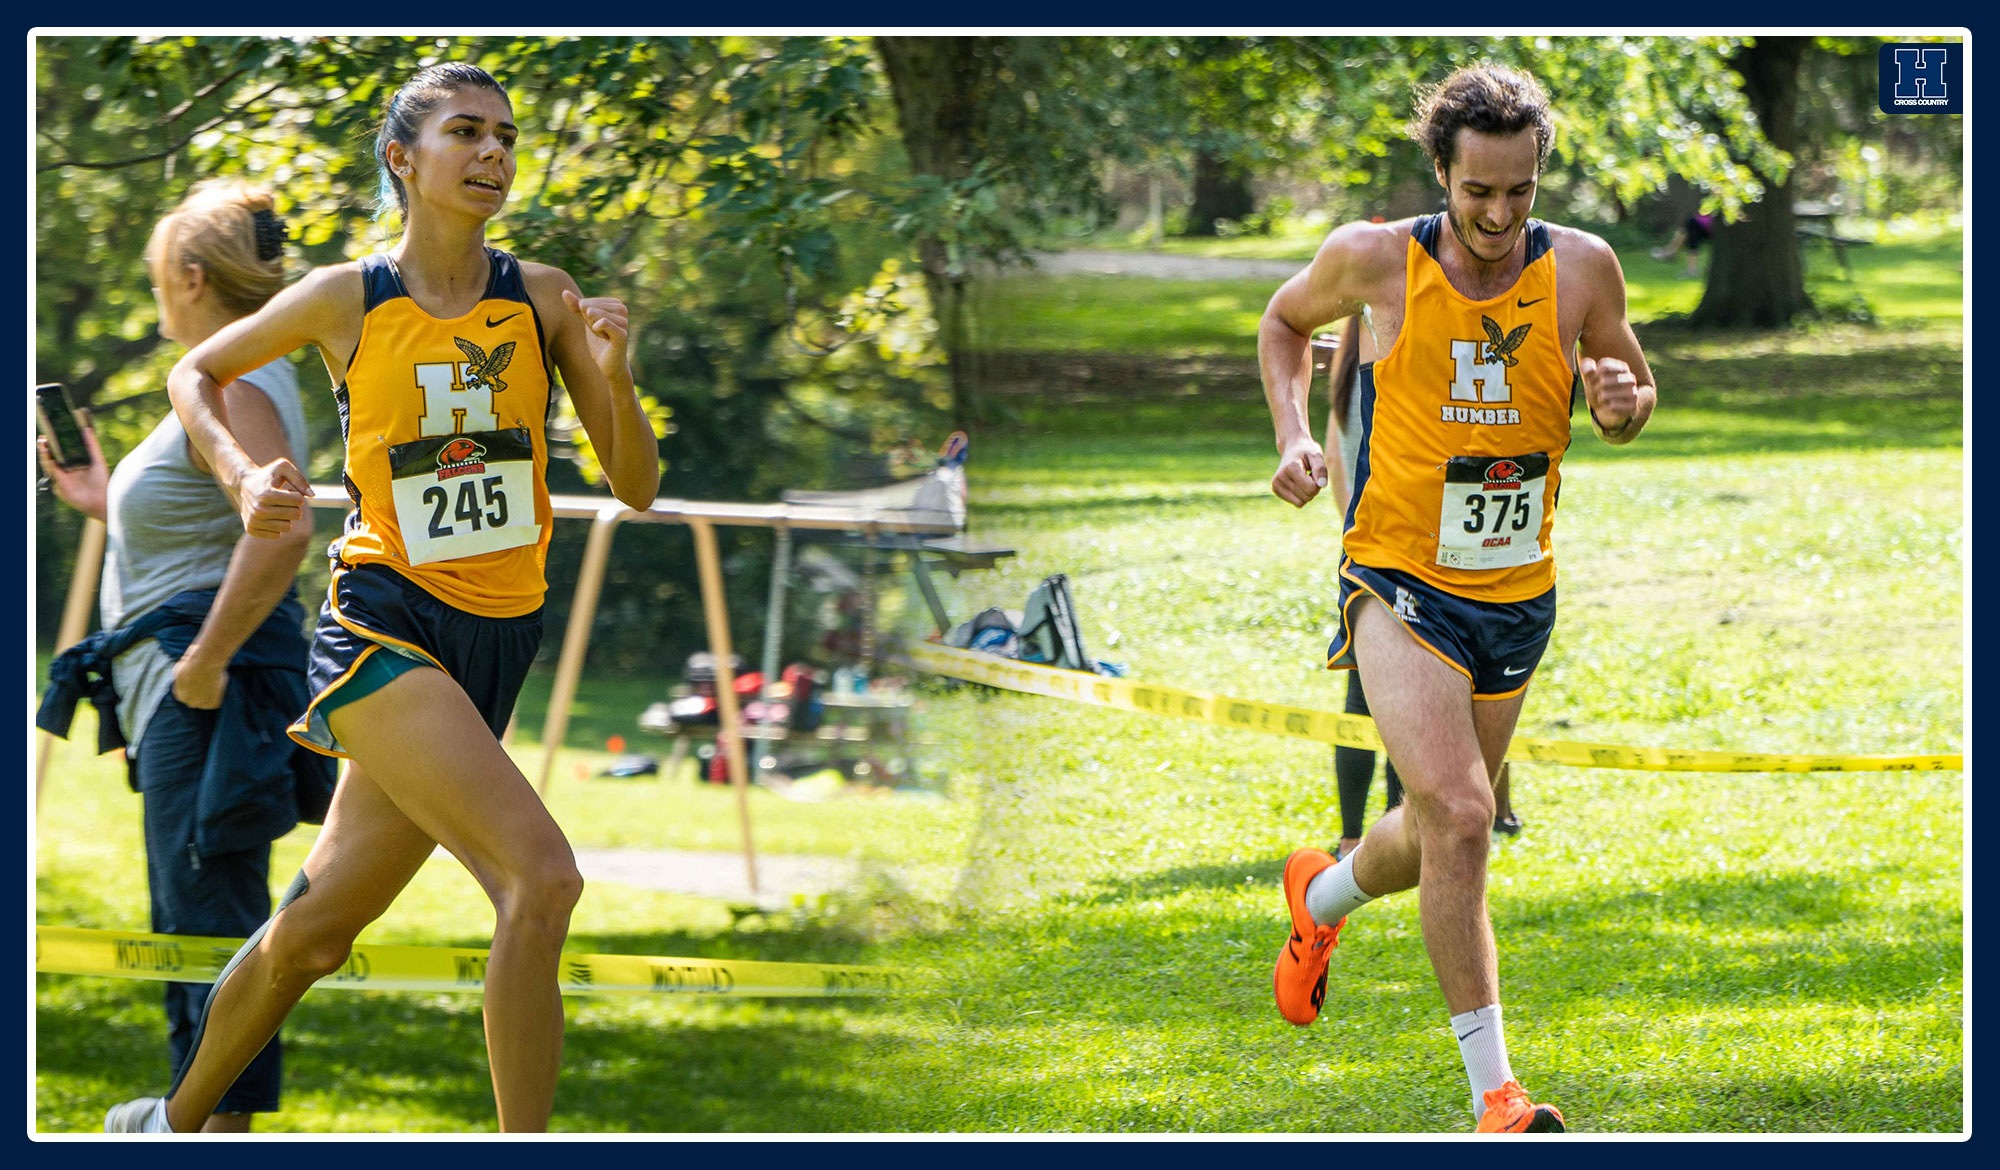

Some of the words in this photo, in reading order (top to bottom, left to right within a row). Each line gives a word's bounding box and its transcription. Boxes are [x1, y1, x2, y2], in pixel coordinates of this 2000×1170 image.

[1449, 339, 1512, 404] H
[414, 361, 500, 440] H
[1441, 405, 1521, 425] HUMBER
[437, 463, 486, 481] FALCONS
[1482, 481, 1522, 492] FALCONS
[422, 475, 509, 540] 245
[1463, 491, 1530, 534] 375
[1481, 536, 1512, 548] OCAA
